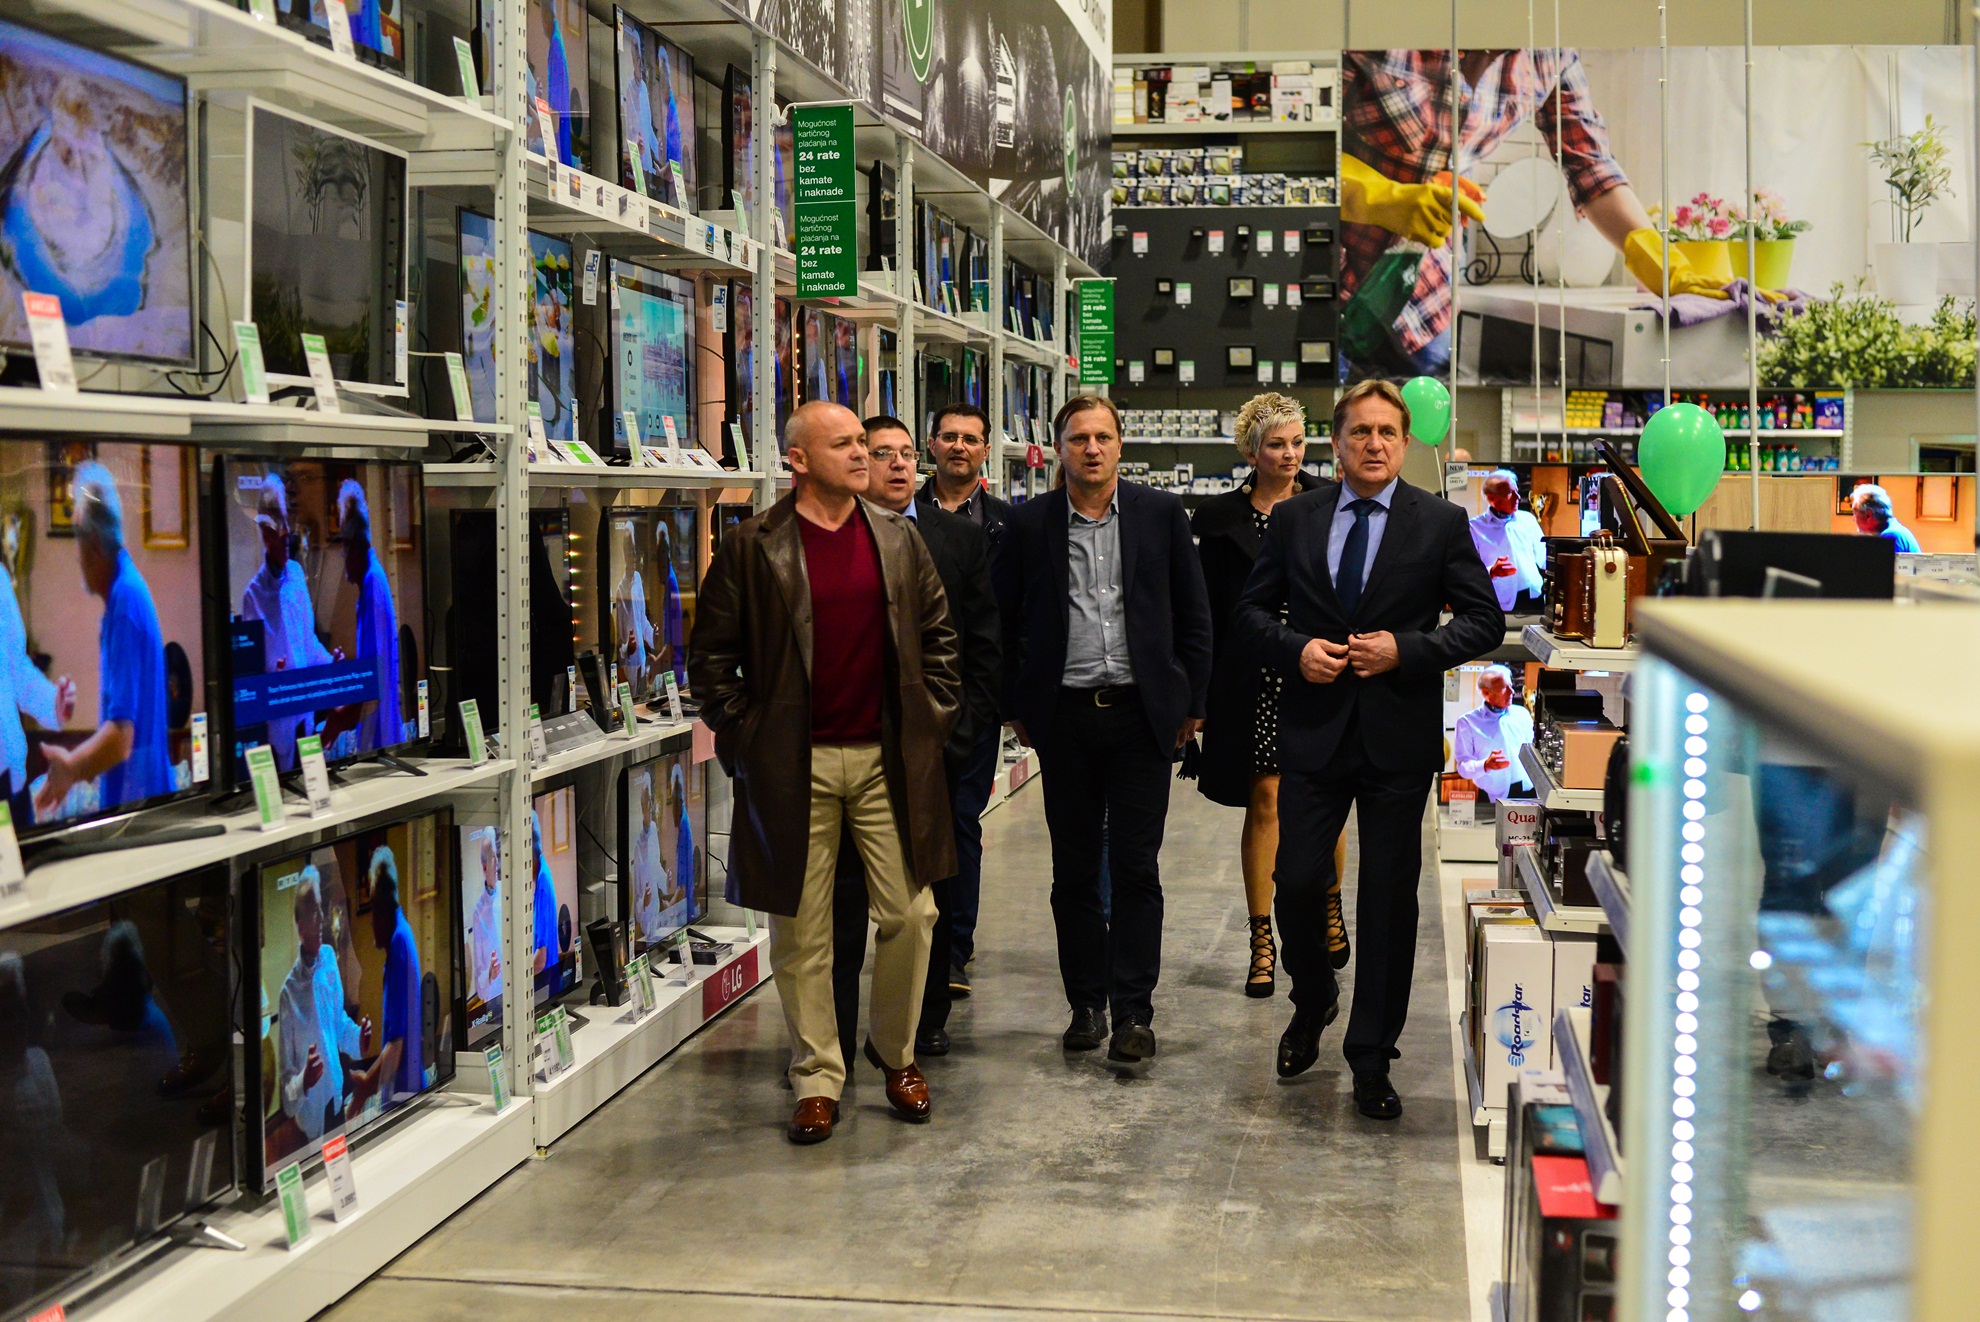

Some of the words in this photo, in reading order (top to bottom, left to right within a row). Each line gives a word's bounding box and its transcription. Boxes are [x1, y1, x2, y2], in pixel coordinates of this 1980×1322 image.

[798, 120, 837, 129] Mogućnost
[798, 130, 830, 138] kartičnog
[798, 140, 827, 149] plaćanja
[799, 151, 814, 161] 24
[817, 150, 840, 160] rate
[799, 165, 816, 173] bez
[799, 176, 833, 185] kamate
[799, 189, 803, 197] i
[805, 187, 844, 197] naknade
[800, 214, 839, 224] Mogućnost
[800, 225, 832, 233] kartičnog
[800, 234, 829, 243] plaćanja
[801, 246, 816, 256] 24
[819, 245, 842, 255] rate
[801, 259, 818, 268] bez
[801, 271, 835, 280] kamate
[801, 283, 805, 292] i
[806, 282, 845, 292] naknade
[1507, 810, 1537, 824] Qua
[731, 964, 743, 993] LG
[1511, 983, 1524, 1057] Roadstar
